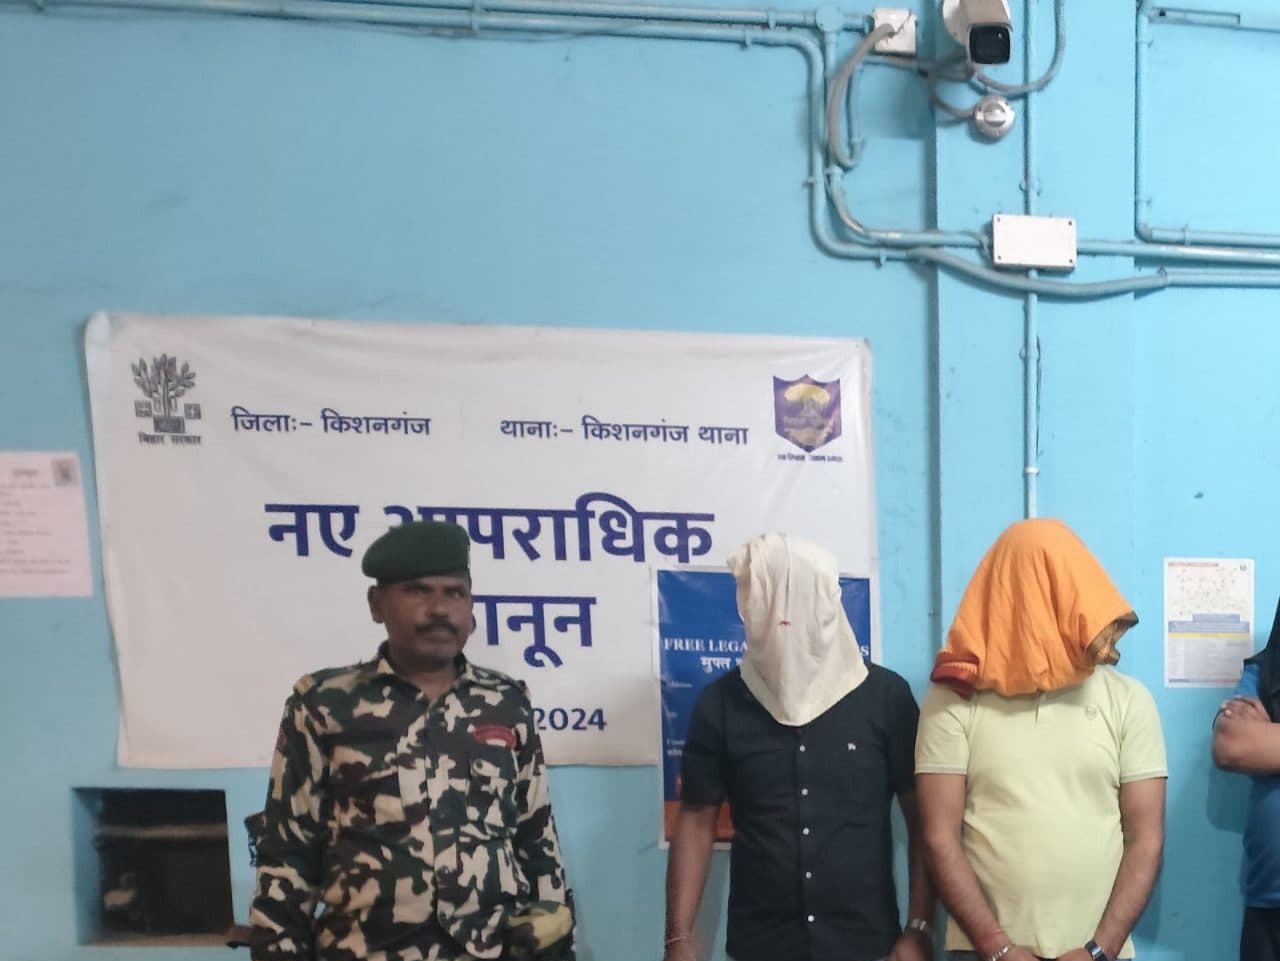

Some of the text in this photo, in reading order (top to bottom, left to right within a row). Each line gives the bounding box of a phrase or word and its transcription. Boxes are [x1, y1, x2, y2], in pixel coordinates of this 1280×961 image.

[321, 407, 432, 436] किशनगंज
[581, 414, 689, 444] किशनगंज
[698, 426, 749, 446] थाना
[264, 491, 716, 564] नए पराधिक
[664, 638, 706, 652] FREE
